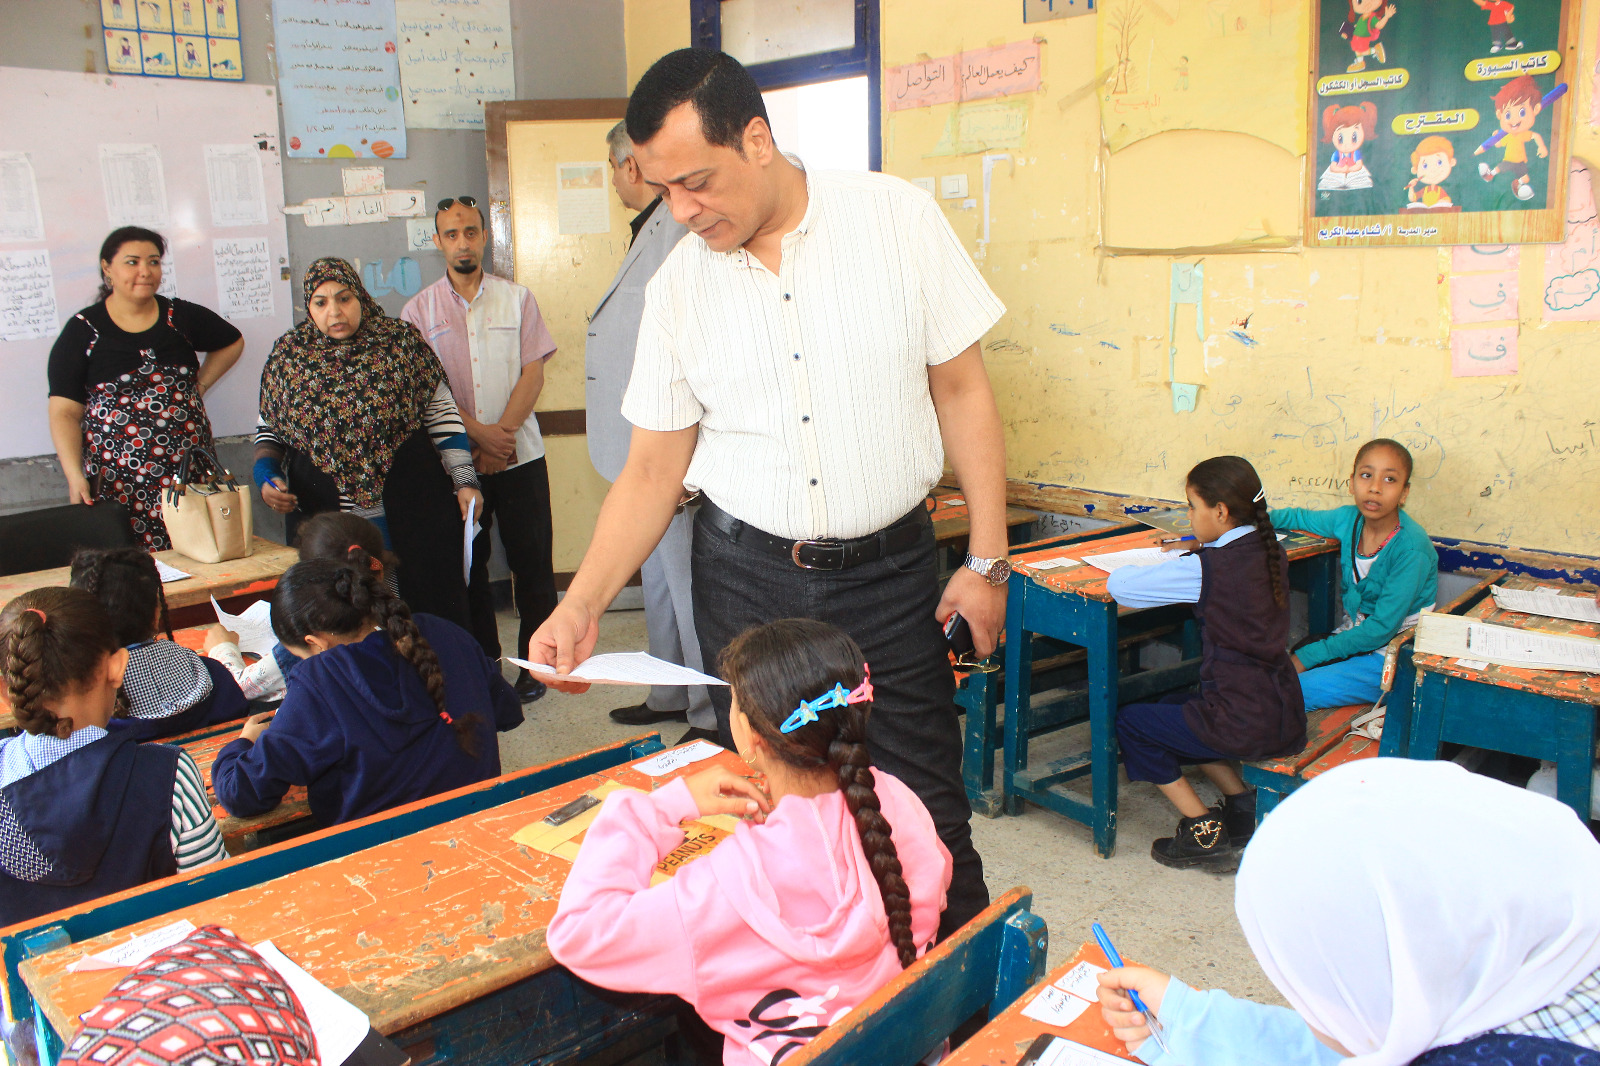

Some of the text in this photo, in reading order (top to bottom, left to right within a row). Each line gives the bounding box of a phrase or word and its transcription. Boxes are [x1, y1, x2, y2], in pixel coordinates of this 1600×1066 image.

[1004, 56, 1036, 77] كيف
[1476, 54, 1549, 76] كاتب السبورة
[896, 64, 945, 99] التواصل
[1319, 80, 1348, 94] الكشكول
[1358, 77, 1382, 90] السجل
[1382, 74, 1403, 88] كاتب
[1404, 112, 1466, 134] المقترح
[1318, 226, 1344, 239] الكريم
[1345, 226, 1360, 238] عبد
[656, 831, 717, 872] PEANUTS
